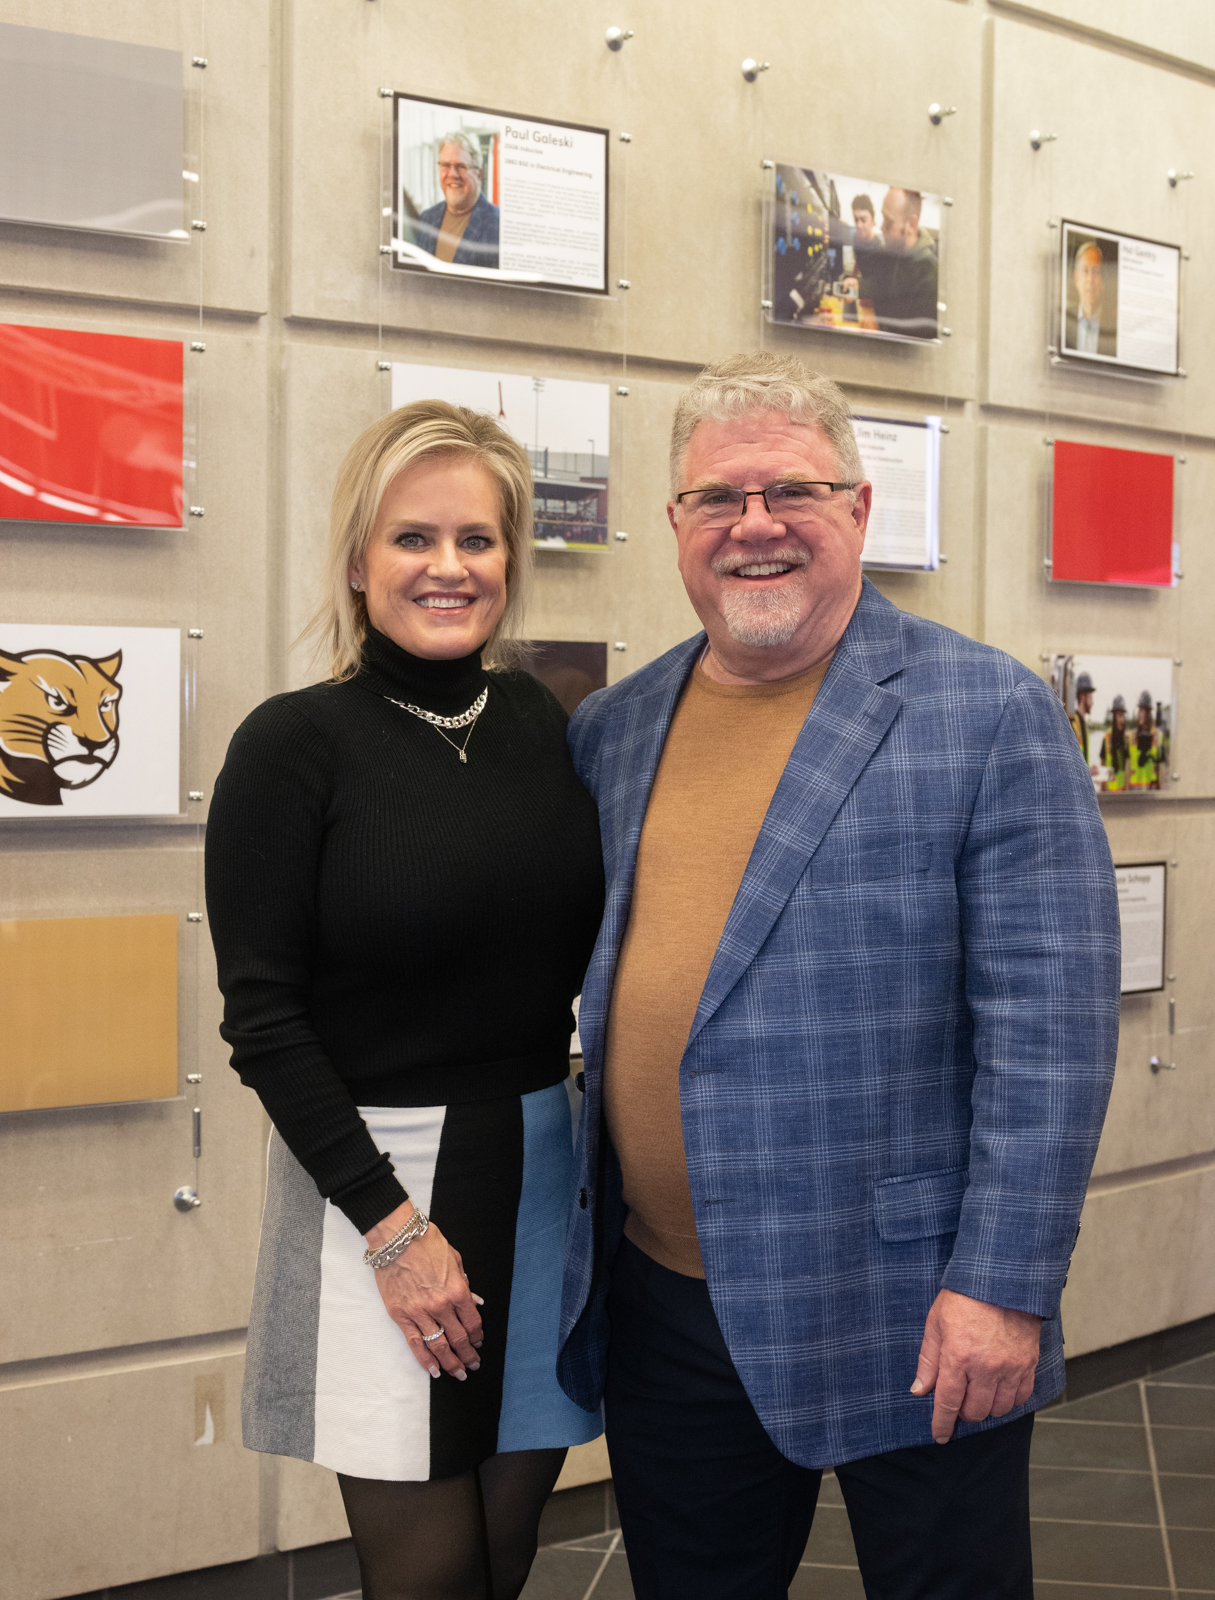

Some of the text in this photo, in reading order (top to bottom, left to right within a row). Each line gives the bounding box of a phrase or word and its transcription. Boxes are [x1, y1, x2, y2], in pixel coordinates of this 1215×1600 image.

[505, 126, 574, 148] Paul Galeski
[536, 163, 561, 173] Electrical
[562, 167, 593, 179] Engineering
[857, 427, 897, 442] Jim Heinz
